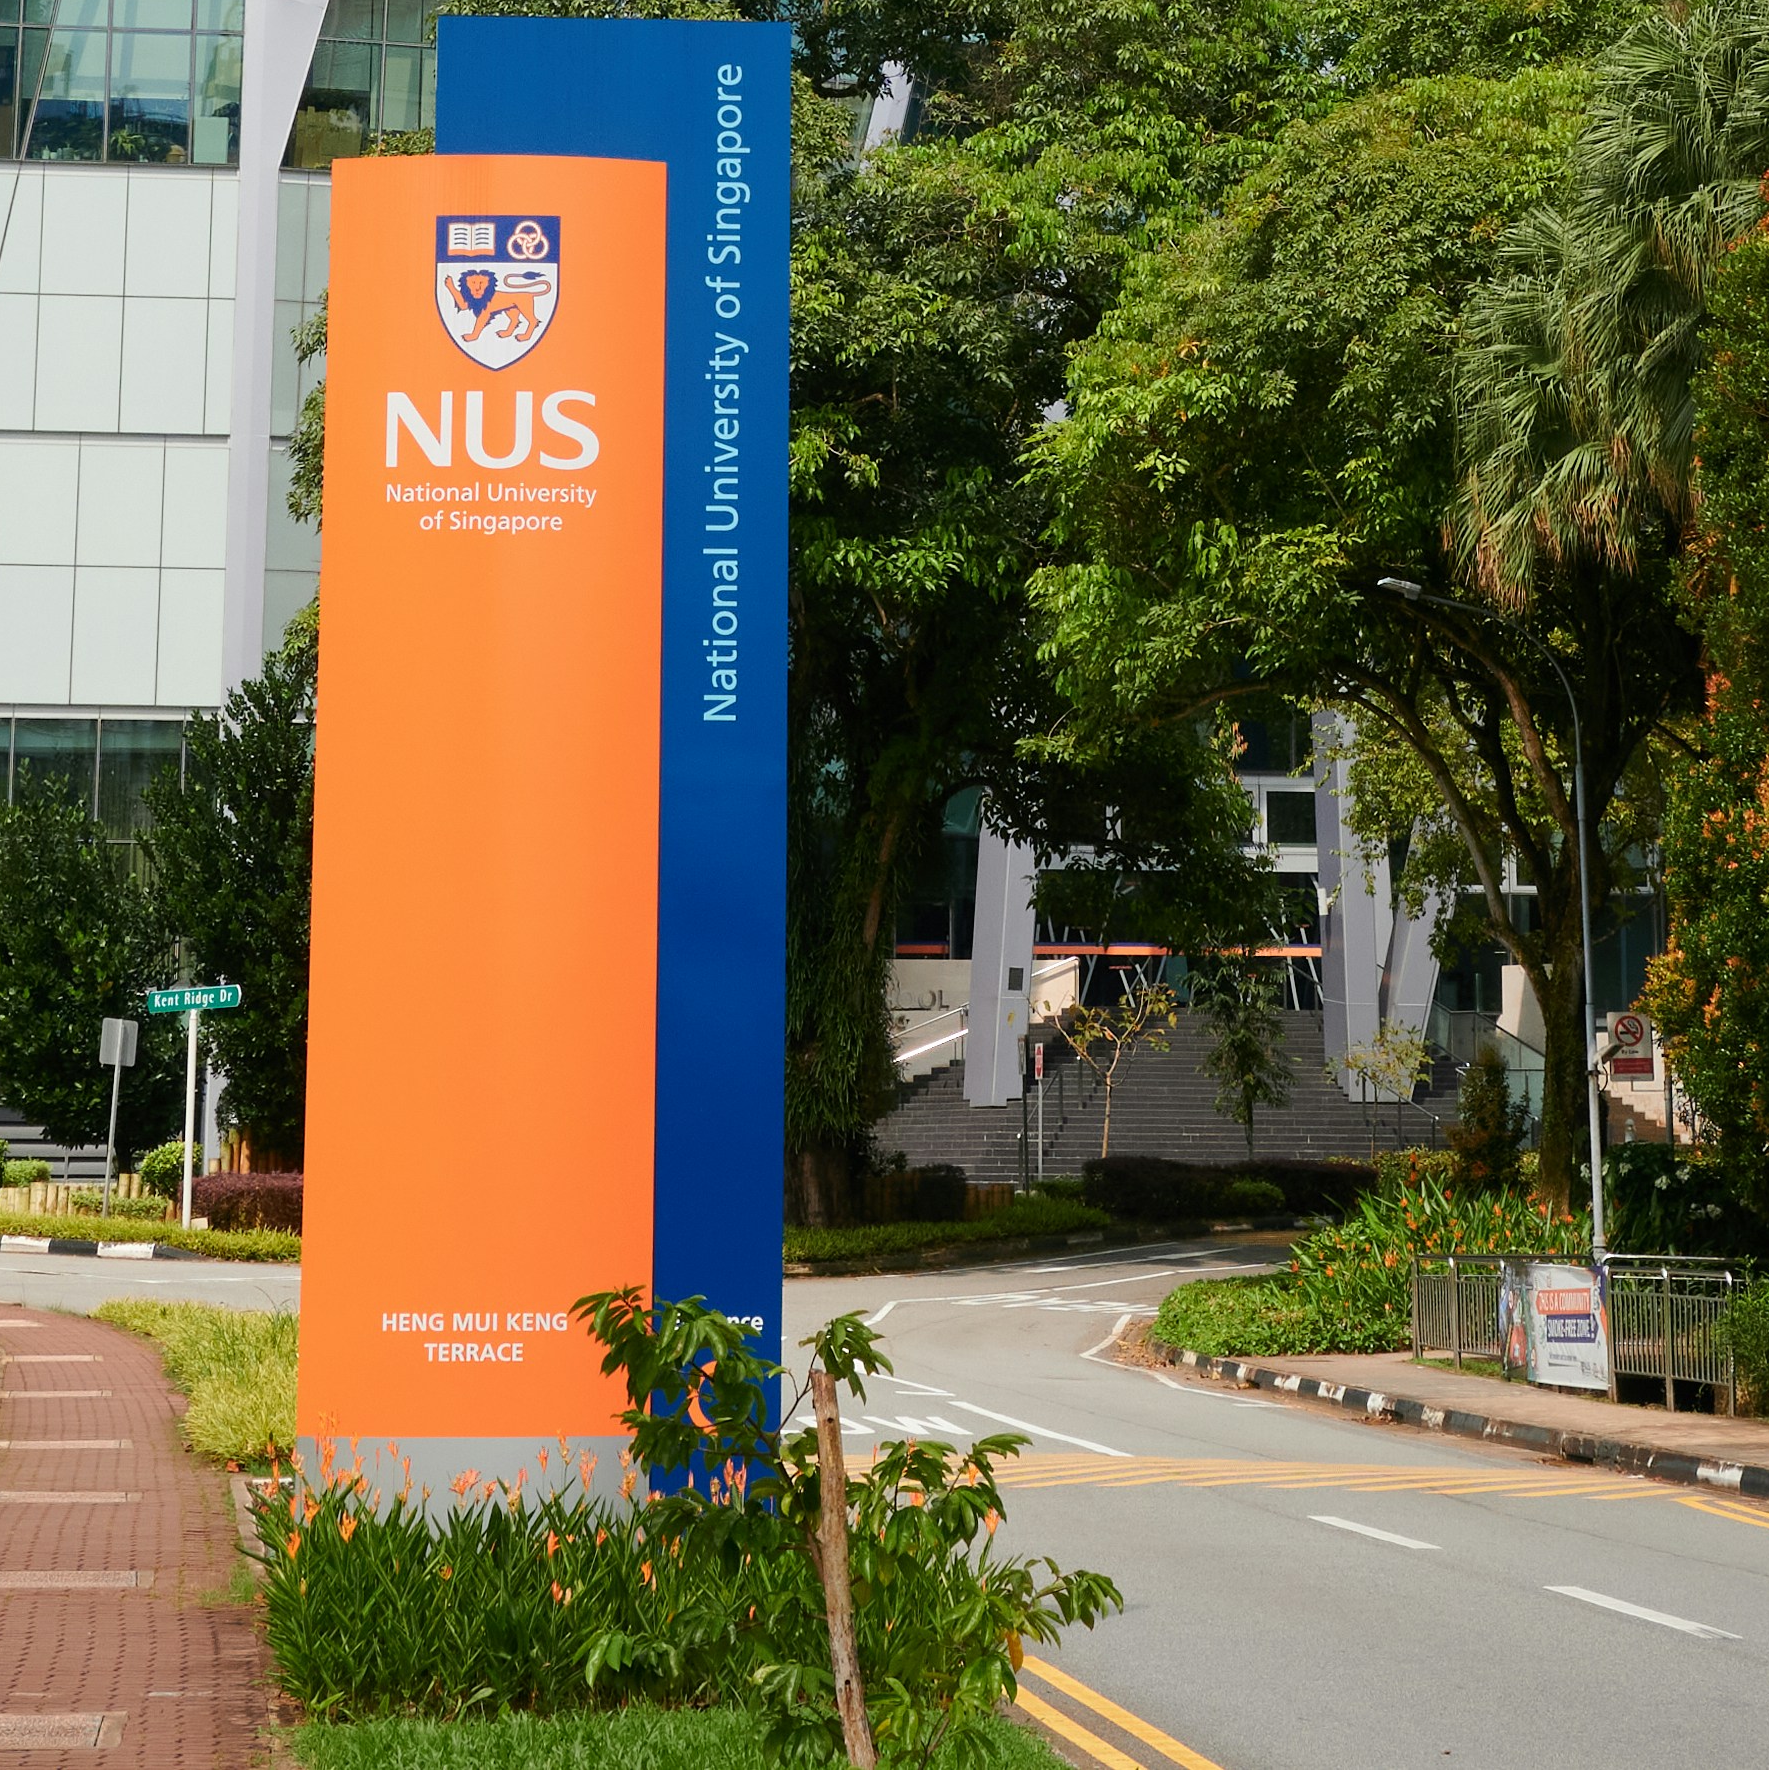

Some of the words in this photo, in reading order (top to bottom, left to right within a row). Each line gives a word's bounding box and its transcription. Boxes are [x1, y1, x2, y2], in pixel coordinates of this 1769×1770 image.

[707, 63, 751, 264] Singapore
[705, 275, 741, 319] of
[385, 389, 600, 471] NUS
[704, 332, 750, 532] University
[386, 482, 480, 503] National
[487, 482, 597, 509] University
[419, 509, 444, 531] of
[449, 510, 564, 535] Singapore
[703, 549, 739, 721] National
[154, 994, 179, 1008] Kent
[184, 991, 215, 1008] Ridge
[219, 989, 233, 1003] Dr
[382, 1313, 445, 1332] HENG
[452, 1312, 498, 1332] MUI
[506, 1312, 568, 1332] KENG
[424, 1342, 524, 1362] TERRACE
